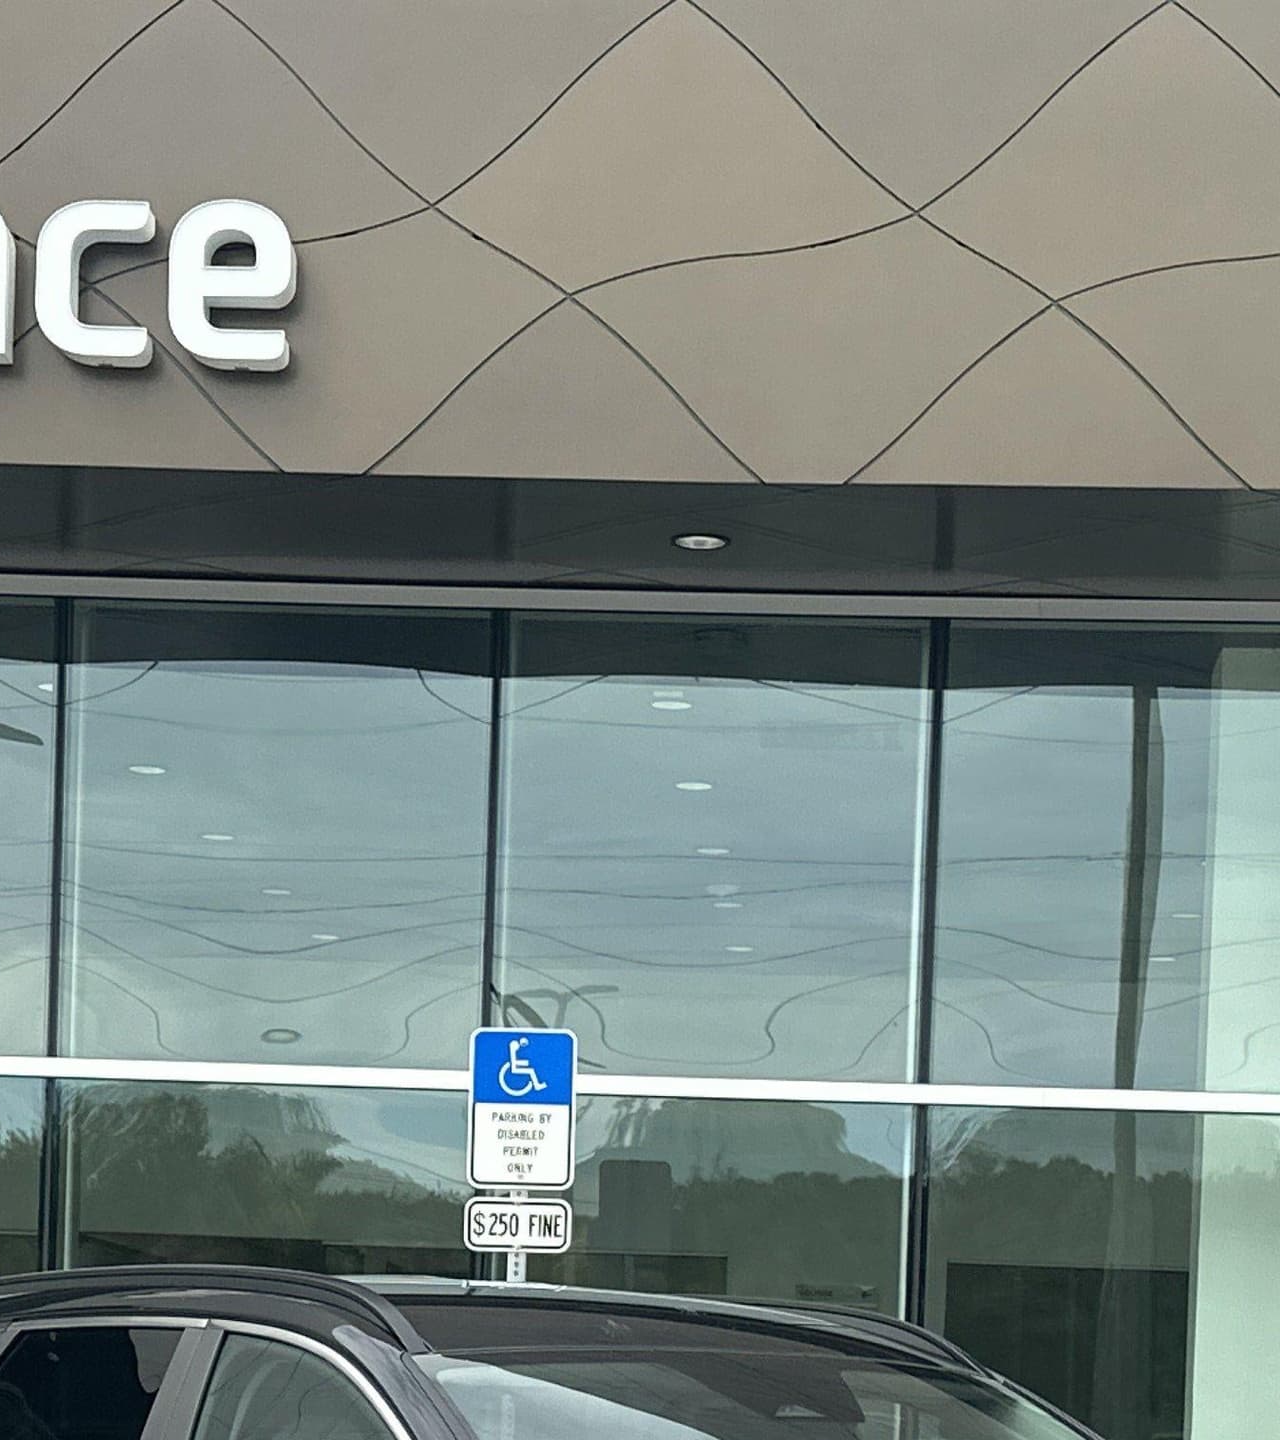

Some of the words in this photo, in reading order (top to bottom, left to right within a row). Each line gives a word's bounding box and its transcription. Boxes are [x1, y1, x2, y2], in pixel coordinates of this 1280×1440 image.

[491, 1111, 535, 1124] PARKING
[538, 1113, 553, 1124] BY
[497, 1128, 546, 1141] DISABLED
[502, 1145, 539, 1158] PERMIT
[507, 1162, 534, 1174] ONLY
[472, 1211, 520, 1238] $250
[528, 1213, 563, 1238] FINE
